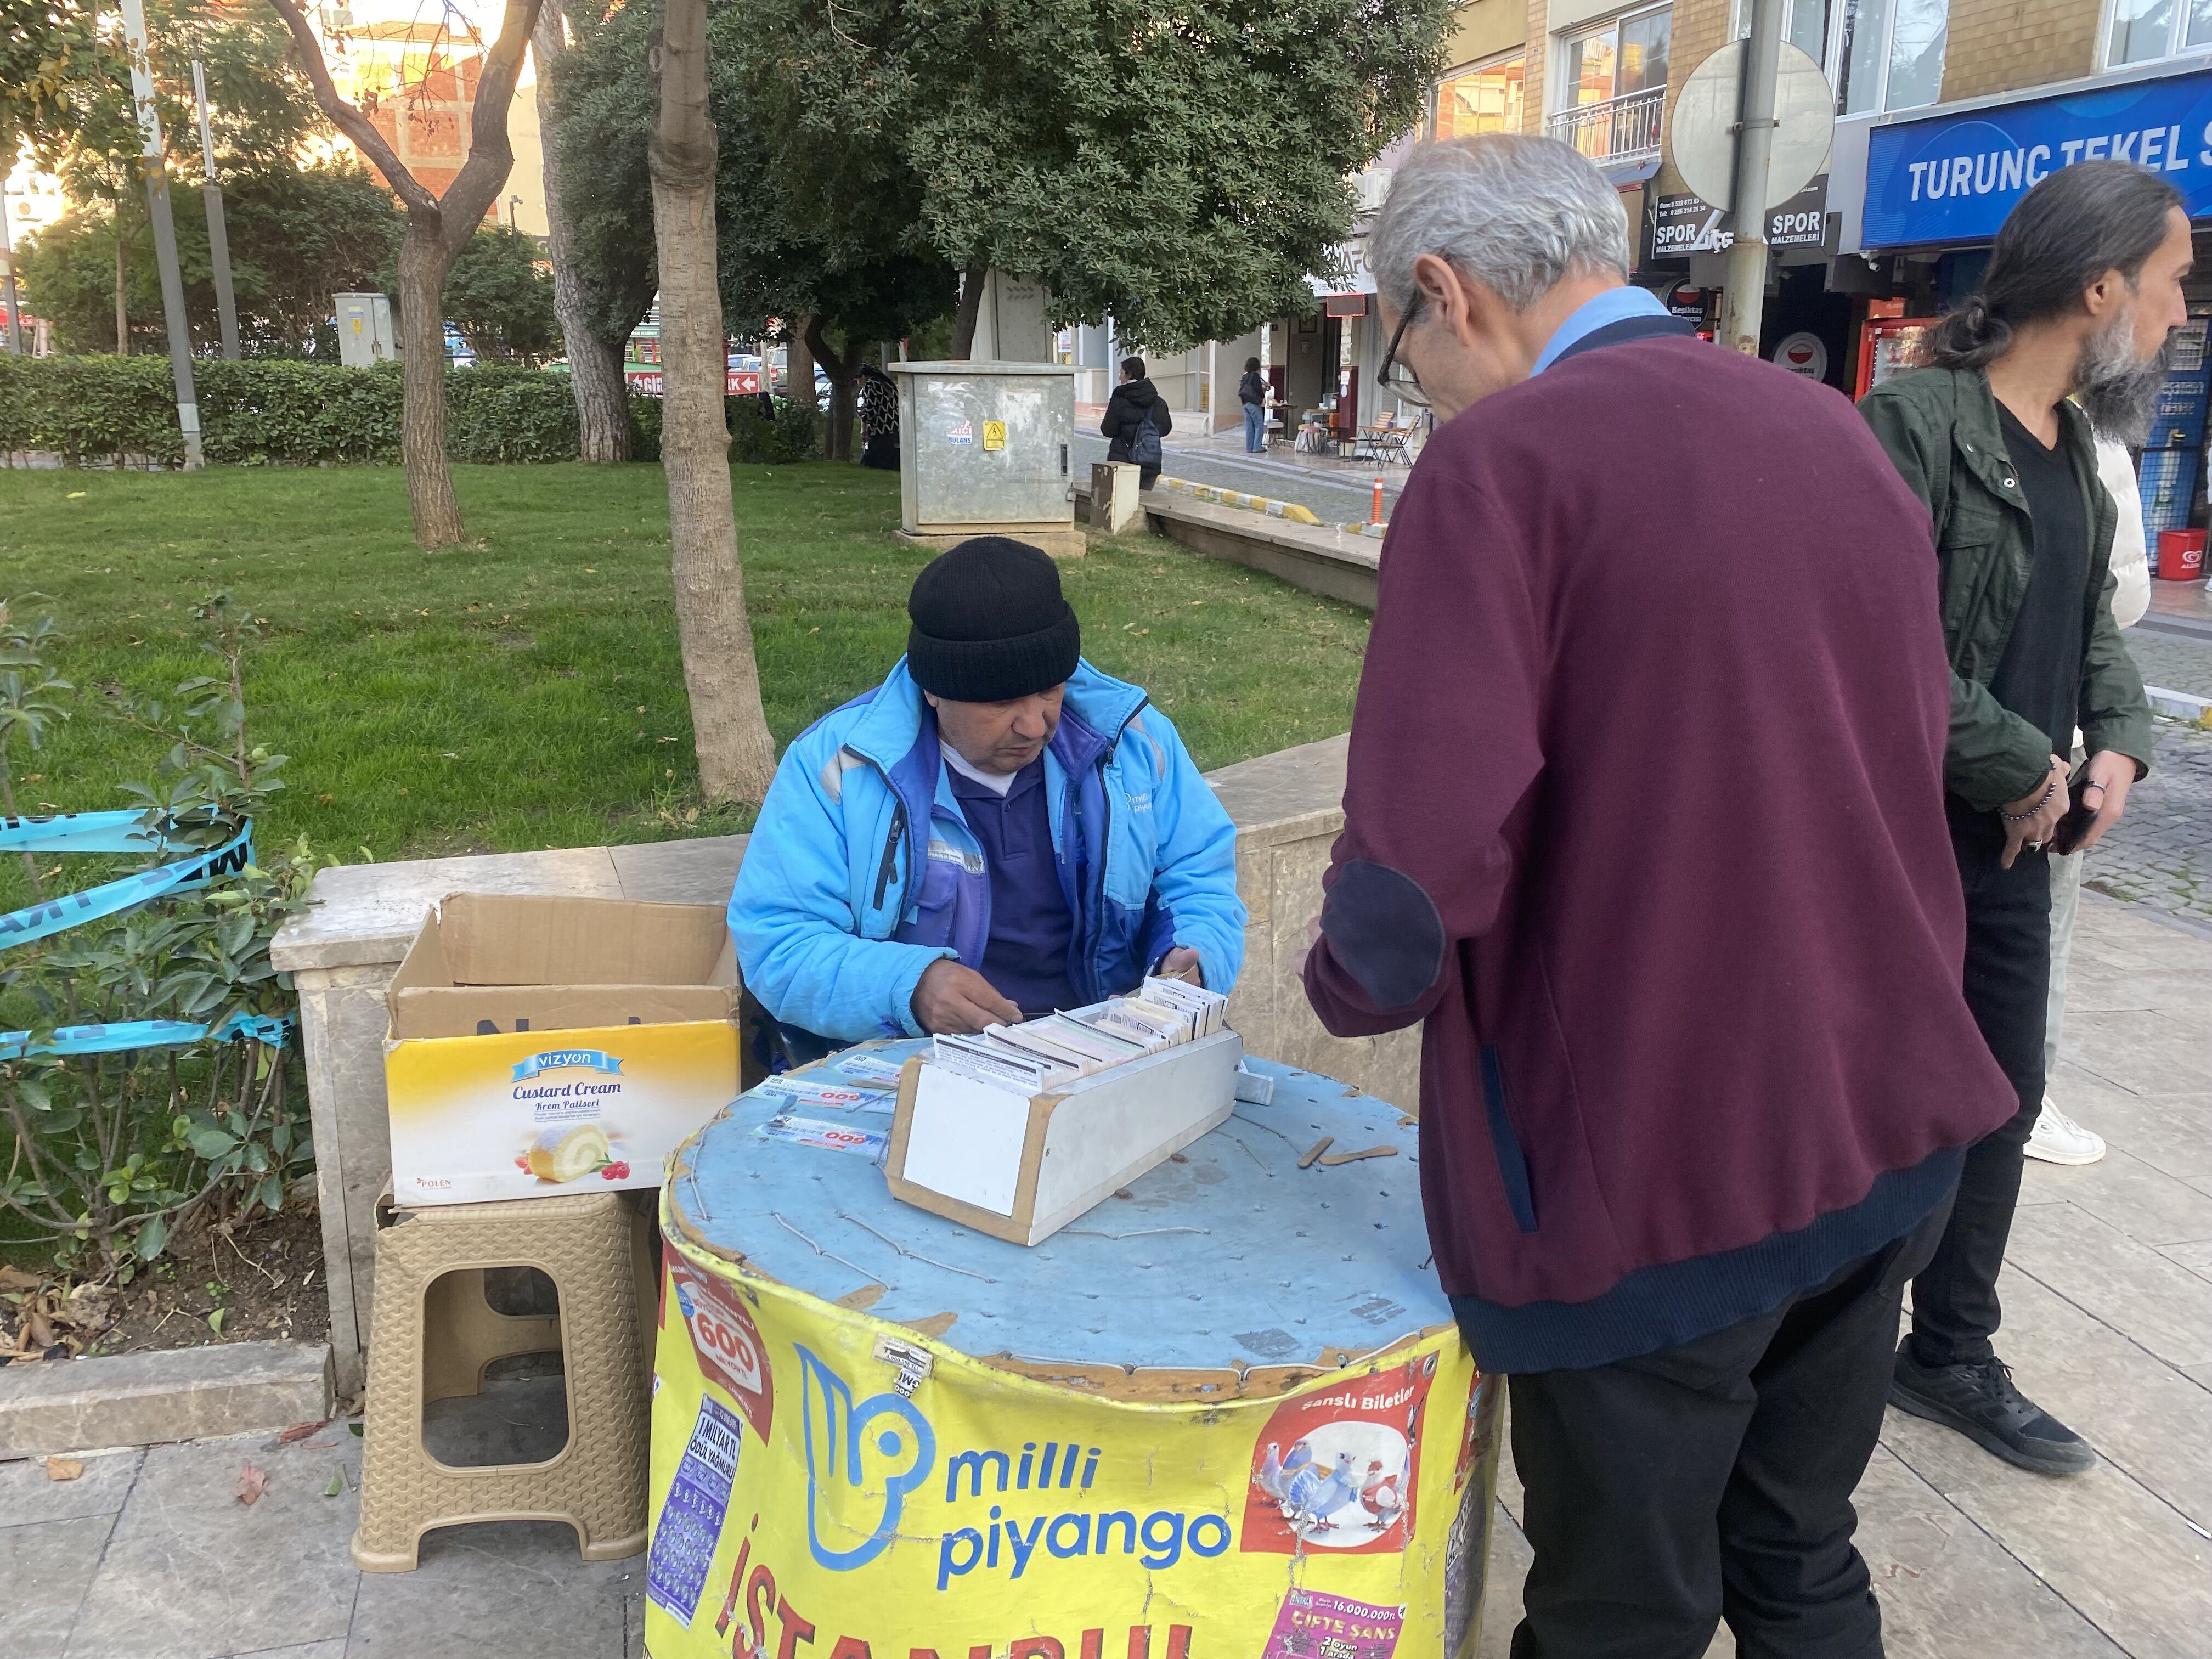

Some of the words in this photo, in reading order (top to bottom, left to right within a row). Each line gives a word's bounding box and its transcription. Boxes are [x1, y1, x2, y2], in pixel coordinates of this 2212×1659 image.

[2060, 124, 2190, 173] TEKEL
[1656, 224, 1696, 244] SPOR
[1772, 211, 1820, 234] SPOR
[1771, 231, 1820, 244] MALZEMELERİ
[539, 1052, 591, 1066] vizyon
[513, 1084, 571, 1100] Custard
[574, 1082, 621, 1096] Cream
[535, 1102, 560, 1110] Krem
[697, 1313, 754, 1372] 600
[1361, 1385, 1414, 1410] Biletler
[699, 1417, 705, 1436] 1
[702, 1420, 730, 1454] MİLYAR
[729, 1438, 736, 1460] TL
[690, 1435, 707, 1459] ÖDÜL
[707, 1448, 735, 1480] YAĞMURU
[946, 1442, 1101, 1503] milli
[937, 1505, 1231, 1590] piyango
[1291, 1610, 1346, 1634] ÇİFTE
[1349, 1624, 1396, 1640] ŞANS
[1320, 1646, 1325, 1655] 1
[1328, 1649, 1355, 1659] arada
[1323, 1636, 1332, 1646] 2
[1334, 1640, 1358, 1651] oyun
